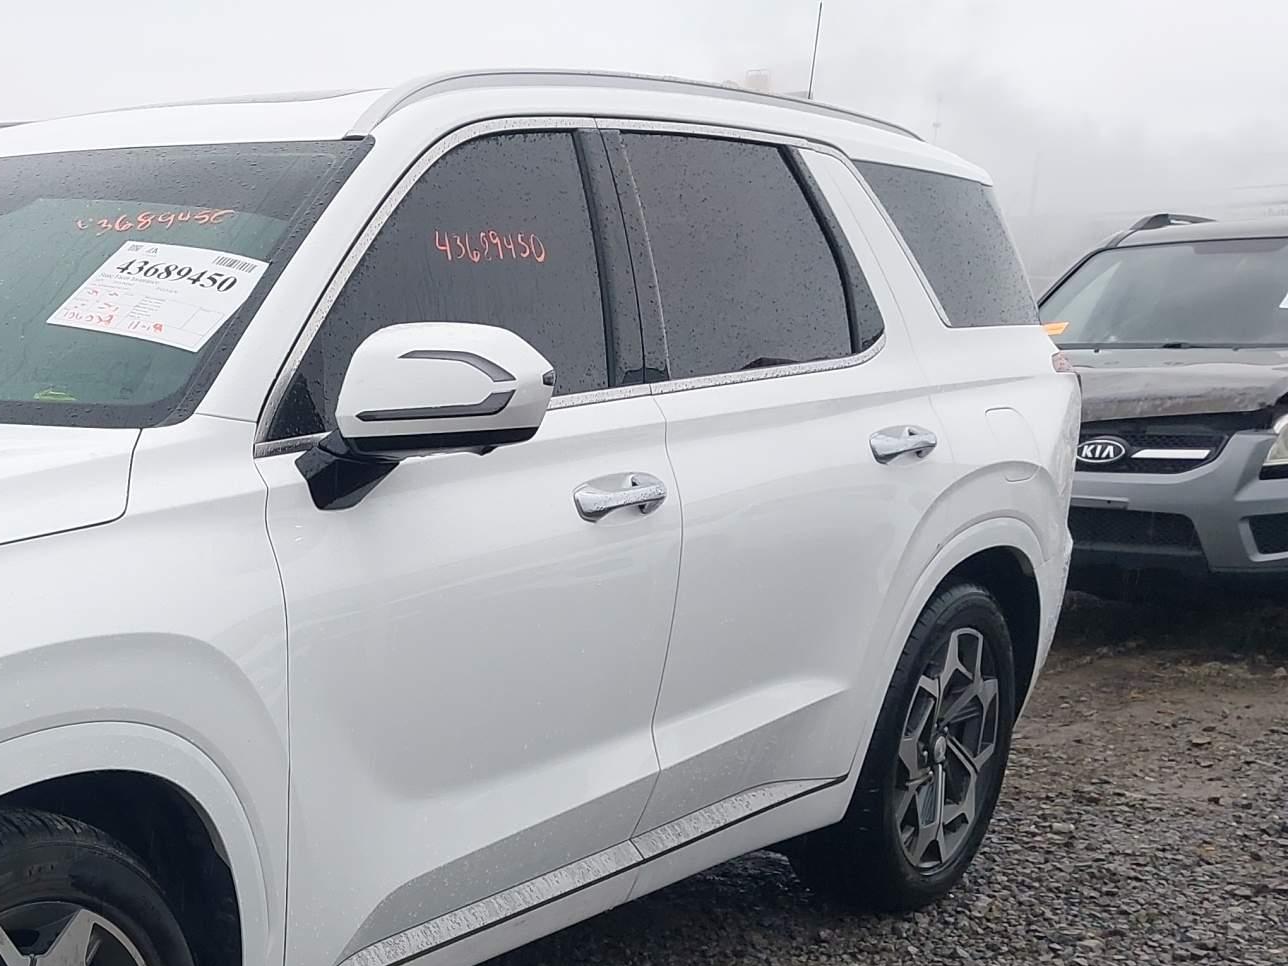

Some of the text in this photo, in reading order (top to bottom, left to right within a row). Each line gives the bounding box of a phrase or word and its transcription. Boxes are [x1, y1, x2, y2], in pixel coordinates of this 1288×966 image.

[435, 230, 545, 263] 43689450
[116, 258, 238, 293] 43689450
[1081, 444, 1115, 458] KIA
